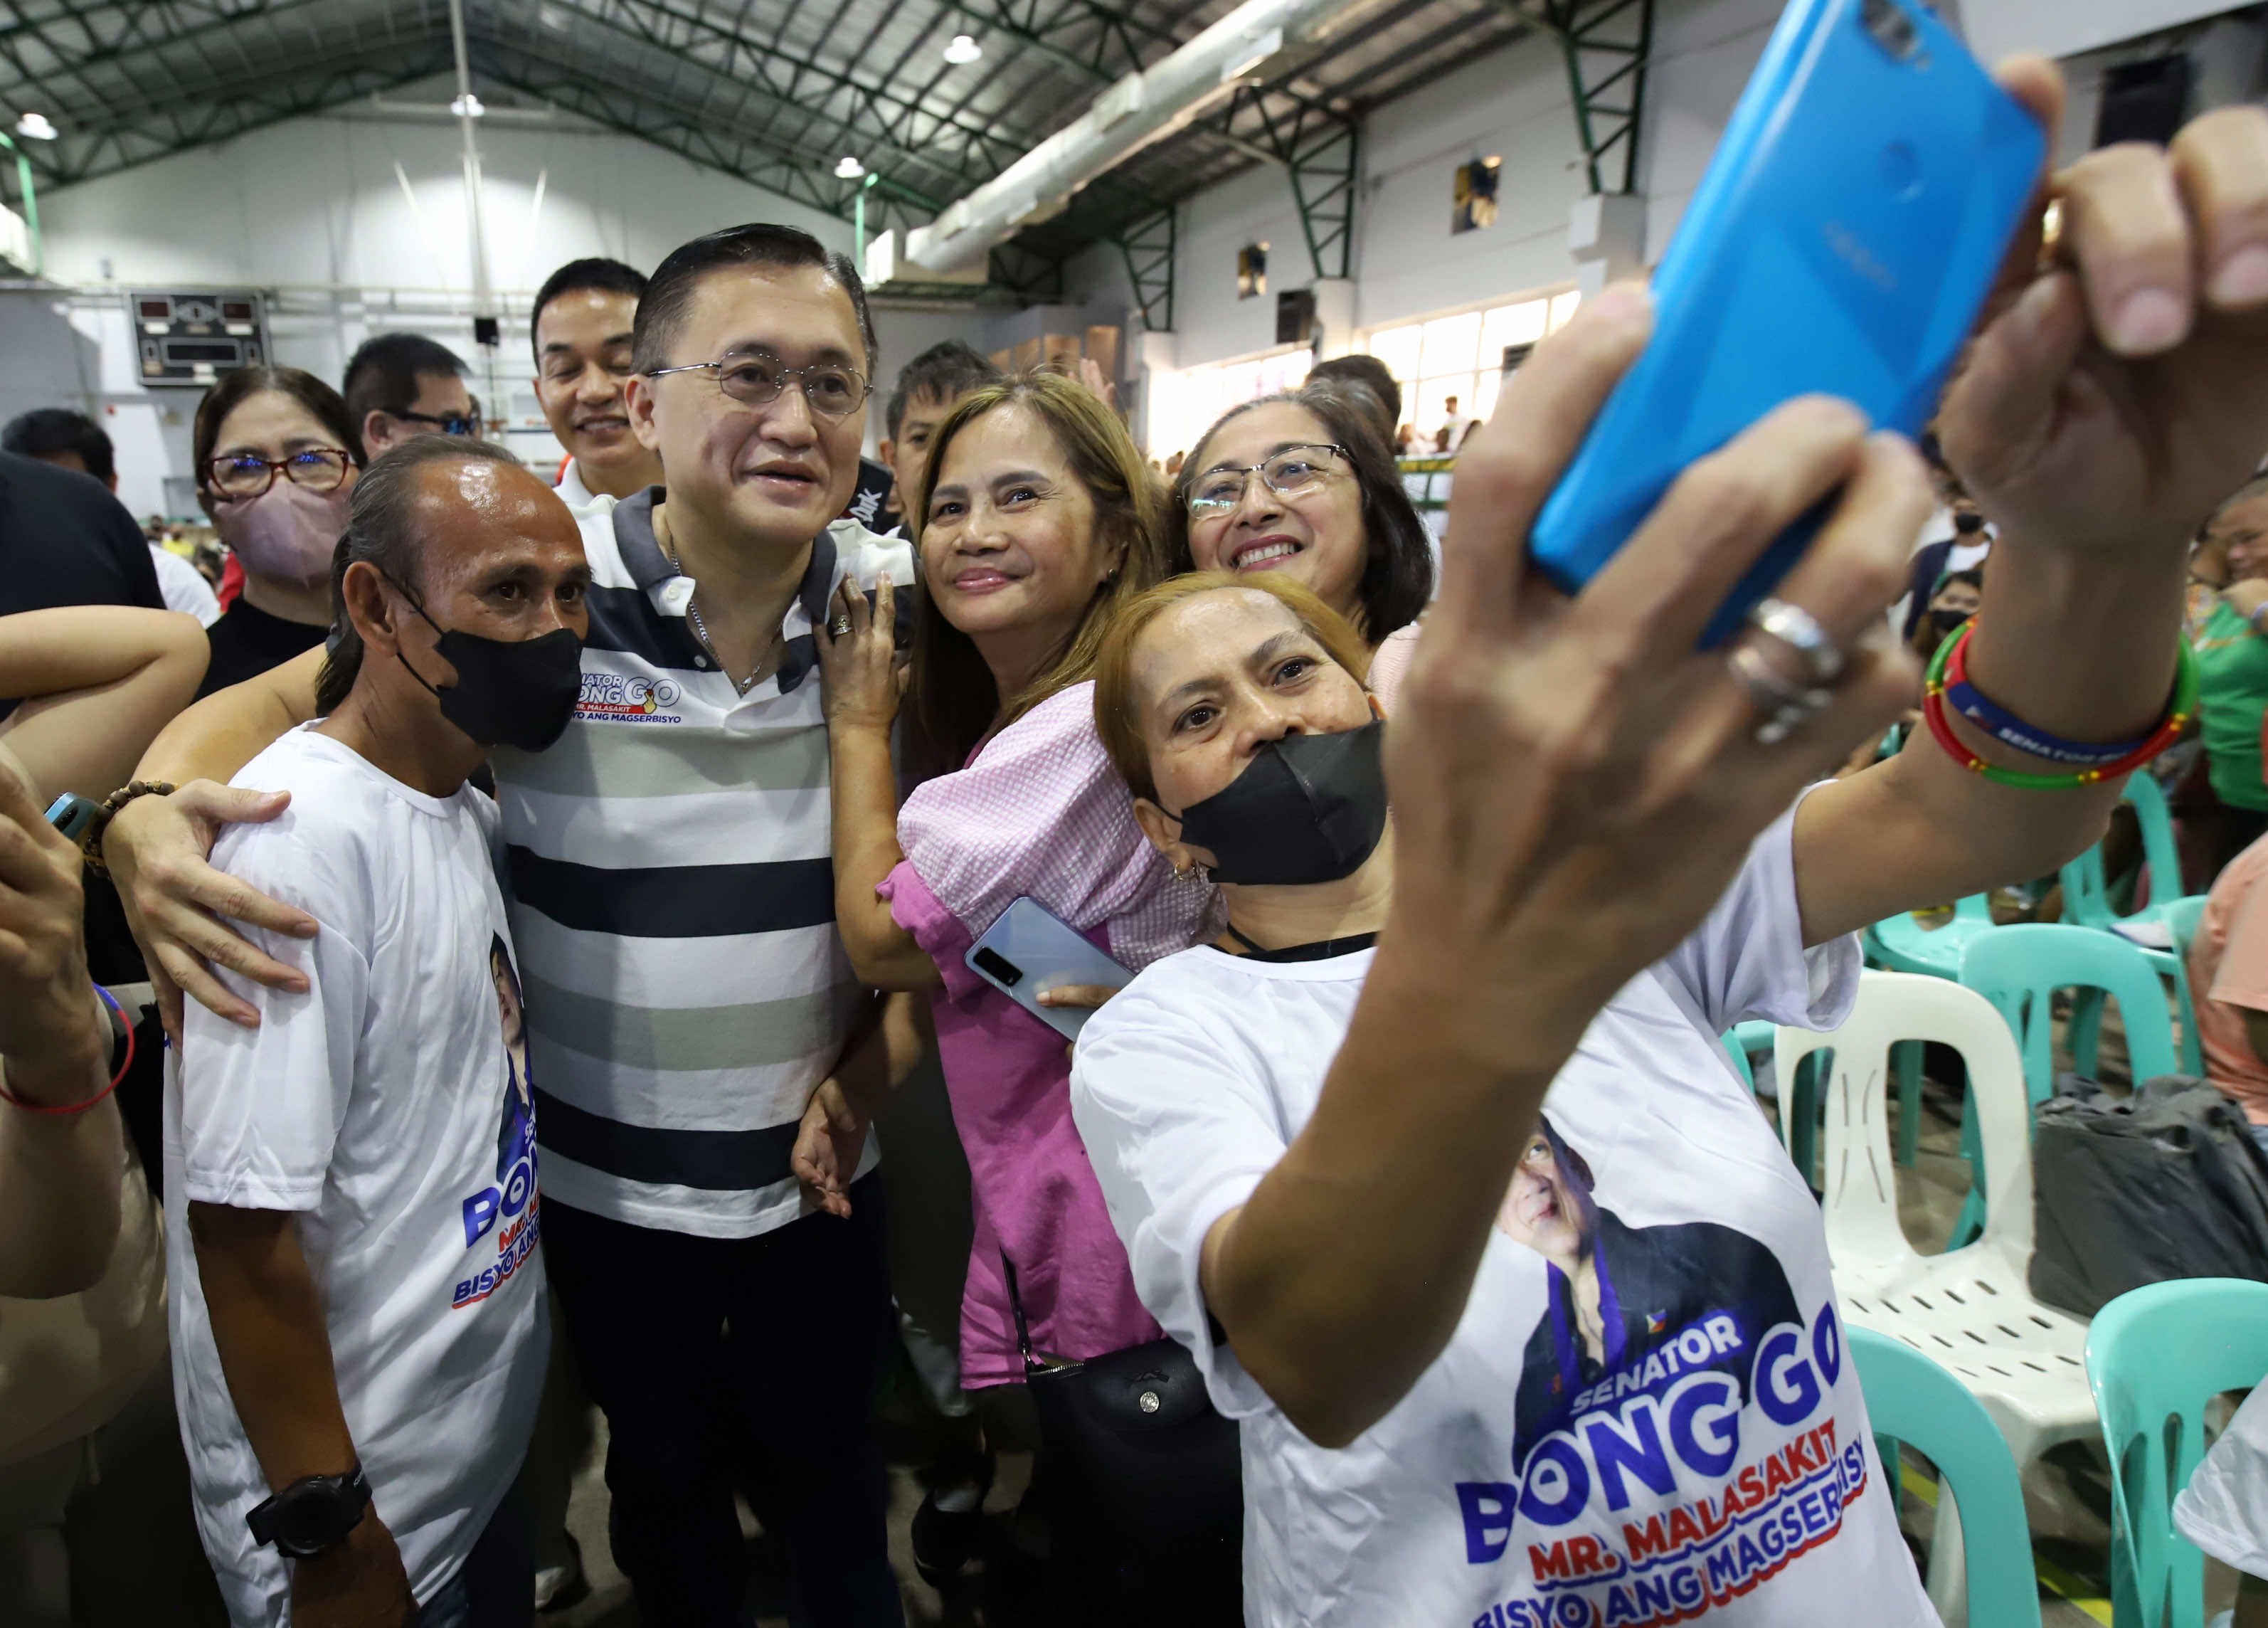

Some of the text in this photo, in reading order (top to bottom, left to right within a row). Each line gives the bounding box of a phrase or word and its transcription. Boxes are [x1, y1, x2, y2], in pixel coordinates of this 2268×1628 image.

[578, 677, 681, 707] ONG GO
[581, 673, 623, 688] ATOR
[587, 704, 632, 712] MALASAKIT
[587, 712, 609, 721] ANG
[611, 714, 682, 724] MAGSERBISYO
[453, 1250, 515, 1302] BISYO
[1570, 1315, 1742, 1416] SENATOR
[1455, 1301, 1841, 1564] BONG GO
[1527, 1415, 1837, 1581] MR. MALASAKIT
[1606, 1566, 1701, 1624] ANG
